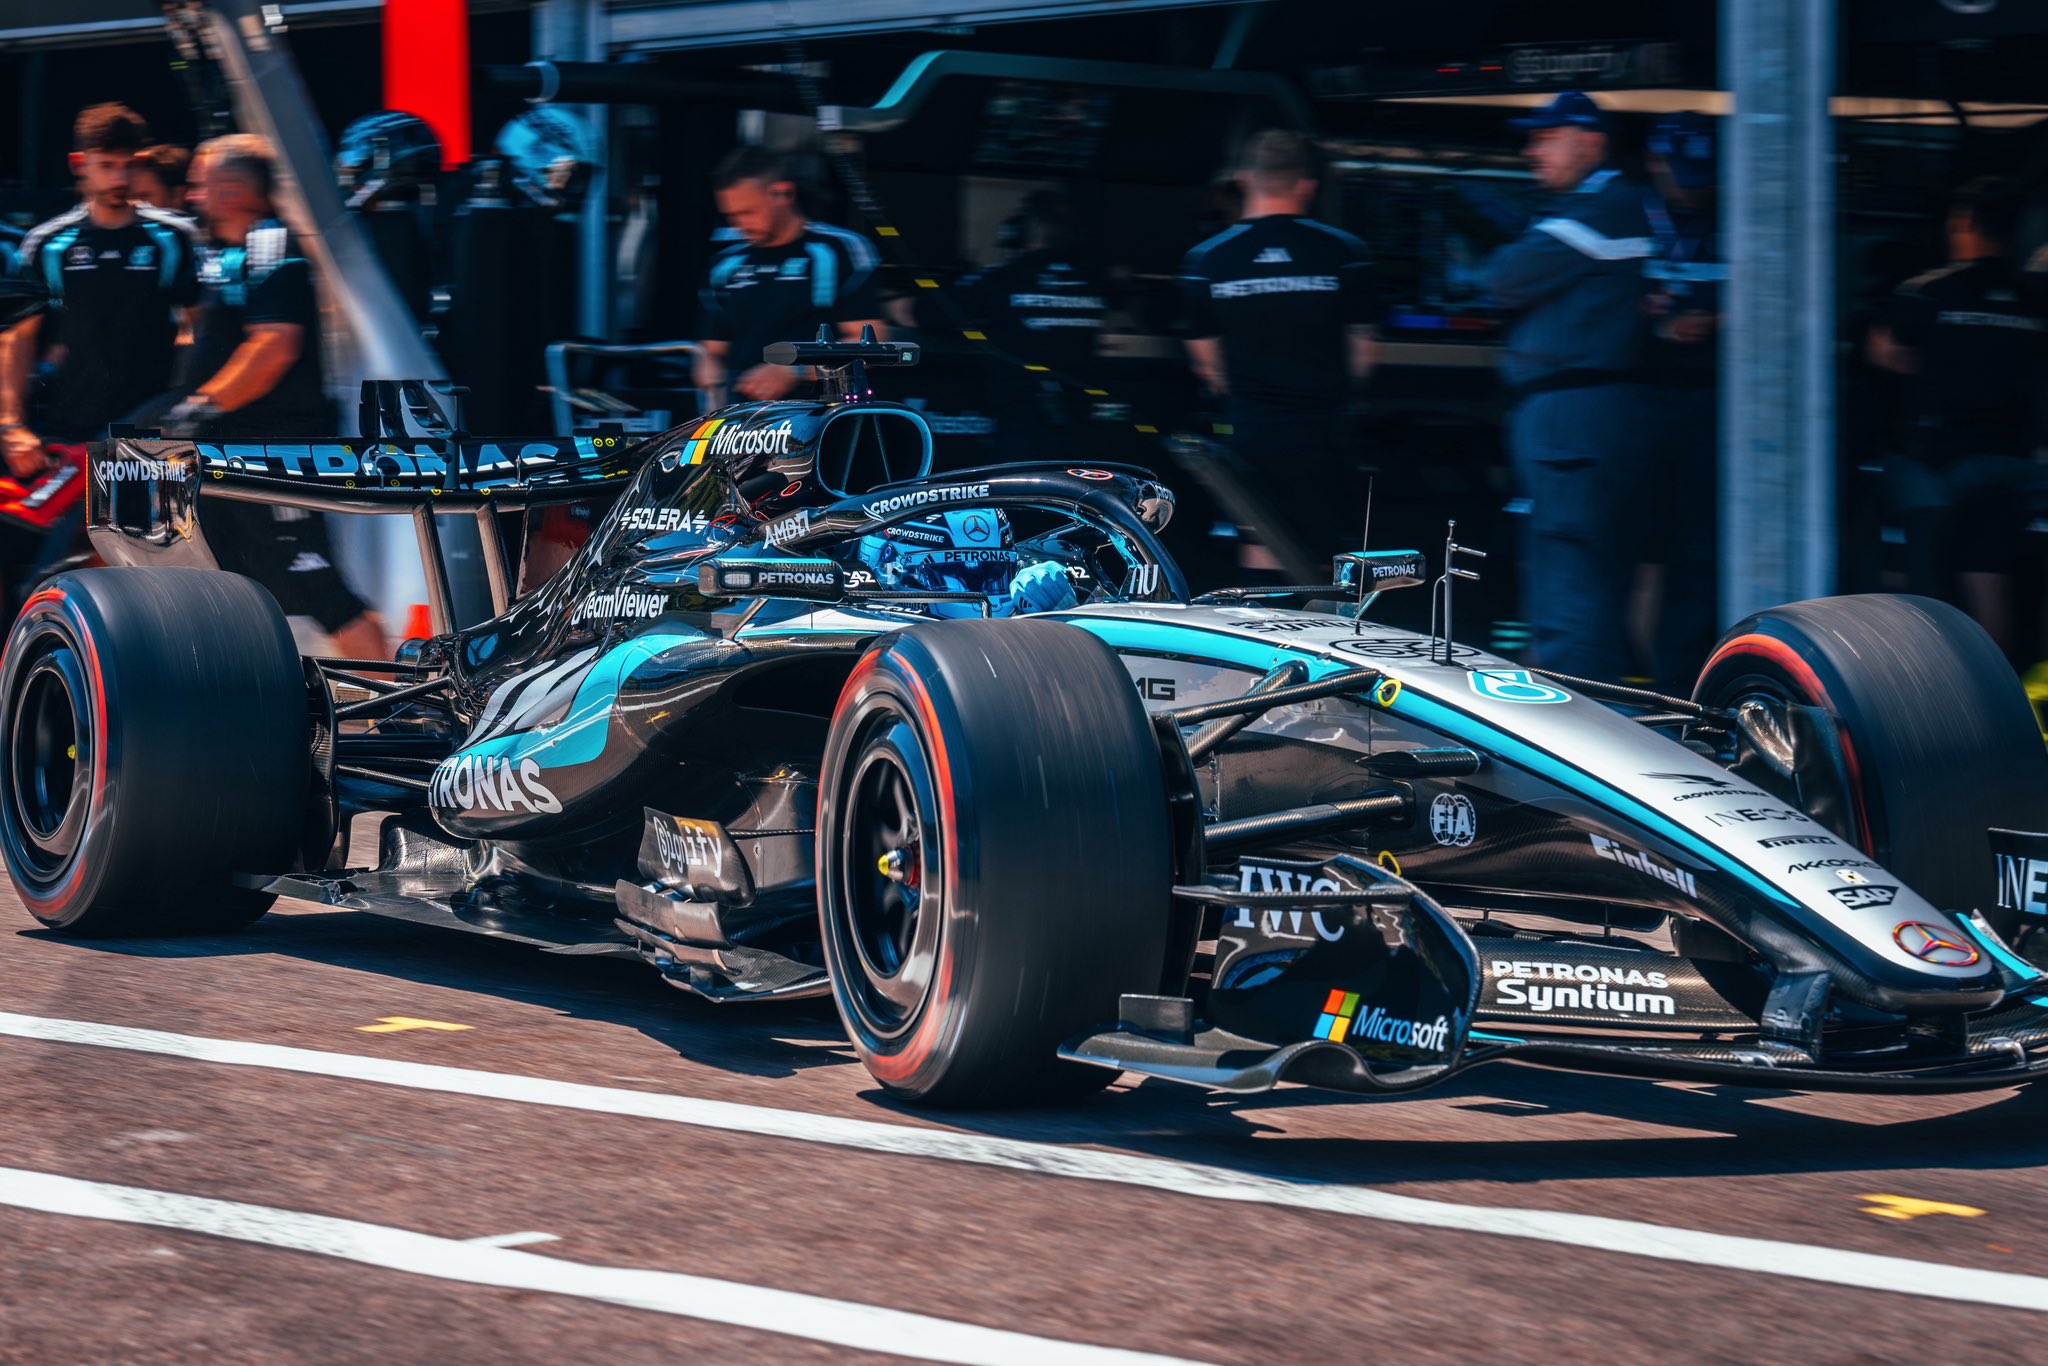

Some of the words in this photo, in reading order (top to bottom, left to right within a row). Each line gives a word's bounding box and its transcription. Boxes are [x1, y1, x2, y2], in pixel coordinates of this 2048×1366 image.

[710, 420, 792, 455] Microsoft
[98, 460, 187, 483] CROWDSTRIKE
[870, 483, 990, 516] CROWDSTRIKE
[630, 508, 692, 532] SOLERA
[762, 518, 797, 550] AMD
[886, 526, 945, 543] CROWDSTRIKE
[944, 551, 1011, 563] PETRONAS
[758, 571, 836, 585] PETRONAS
[1372, 563, 1417, 578] PETRONAS
[582, 586, 669, 619] TeamViewer
[428, 754, 563, 814] TRONAS
[1672, 788, 1772, 802] CROWDSTRIKE
[1705, 807, 1811, 827] INEOS
[1757, 834, 1840, 849] PIRELLI
[1589, 832, 1698, 899] Einhell
[1233, 865, 1345, 942] IWC
[1832, 886, 1897, 909] SAP
[1491, 960, 1669, 989] PETRONAS
[1496, 978, 1676, 1016] Syntium
[1352, 1003, 1449, 1053] Microsoft
